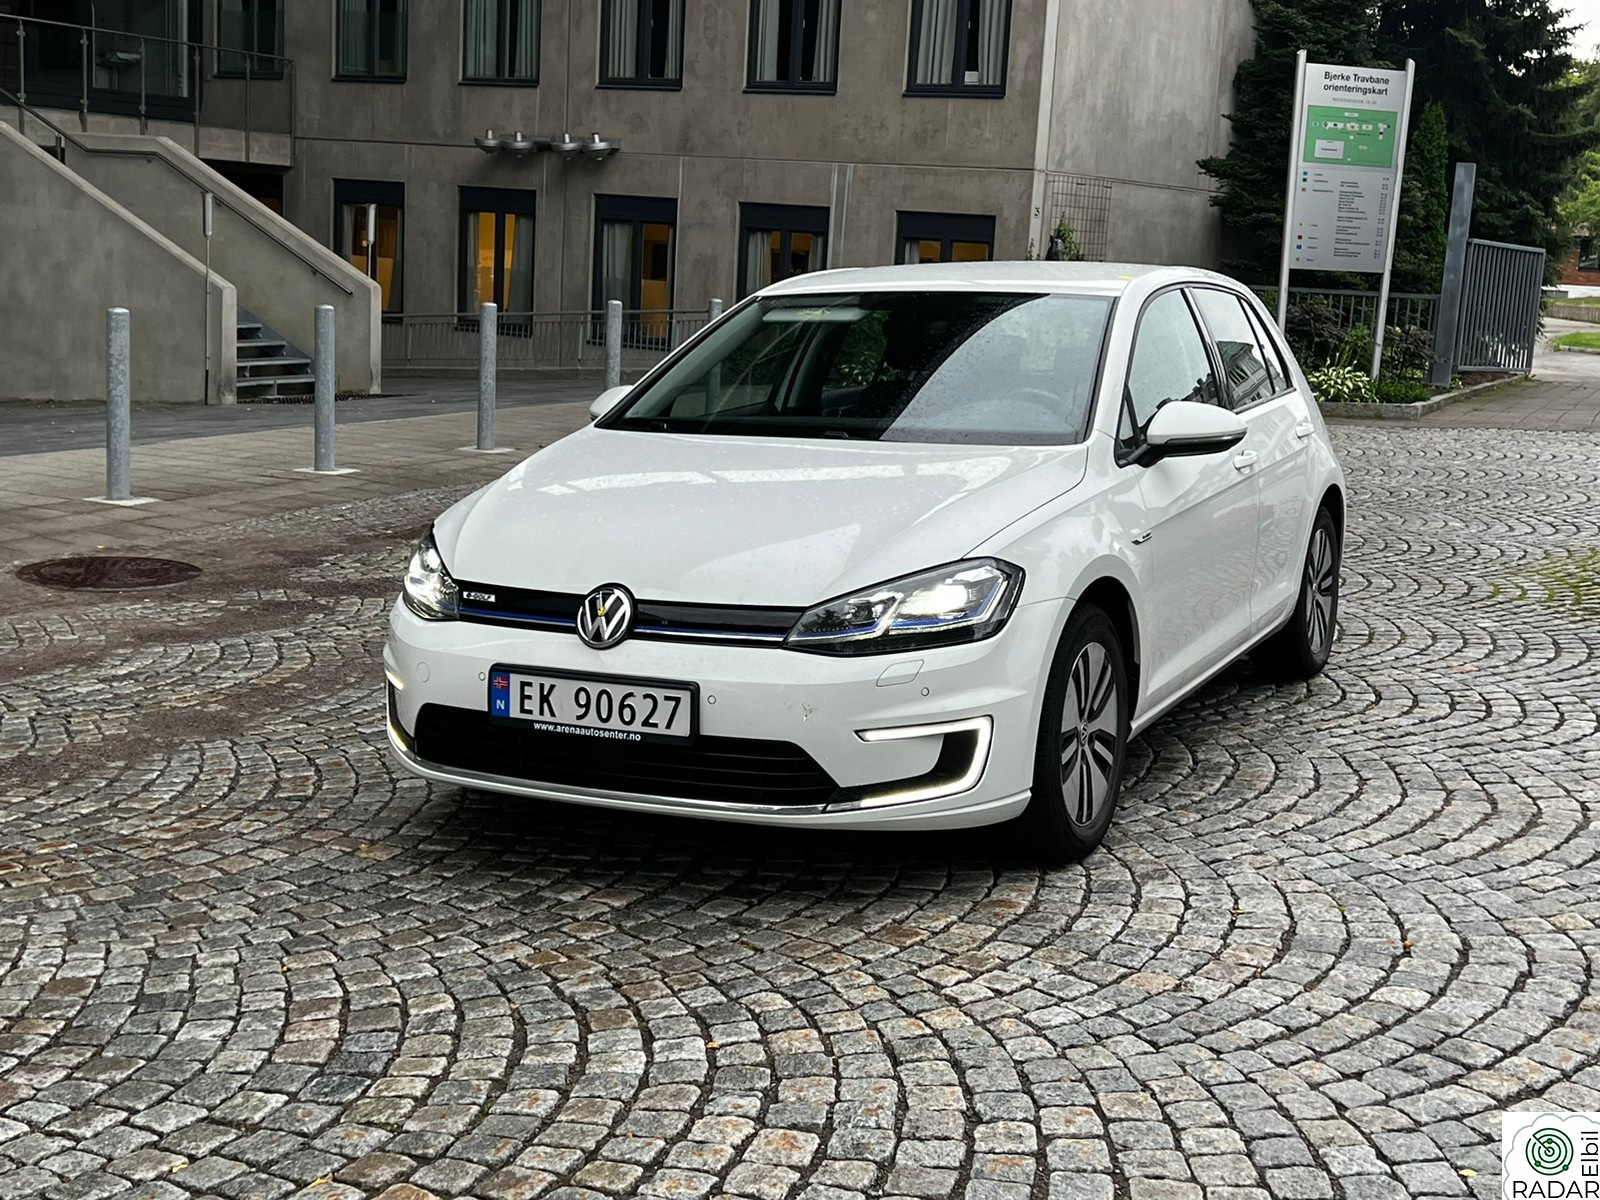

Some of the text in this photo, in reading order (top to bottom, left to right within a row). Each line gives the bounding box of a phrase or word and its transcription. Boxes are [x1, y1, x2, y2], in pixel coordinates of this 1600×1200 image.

[1324, 71, 1390, 85] Bjerke Travbane
[1323, 82, 1388, 96] orienteringskart
[496, 700, 505, 710] N
[519, 680, 682, 730] EK 90627
[533, 722, 642, 742] www.arenaautosenter.no
